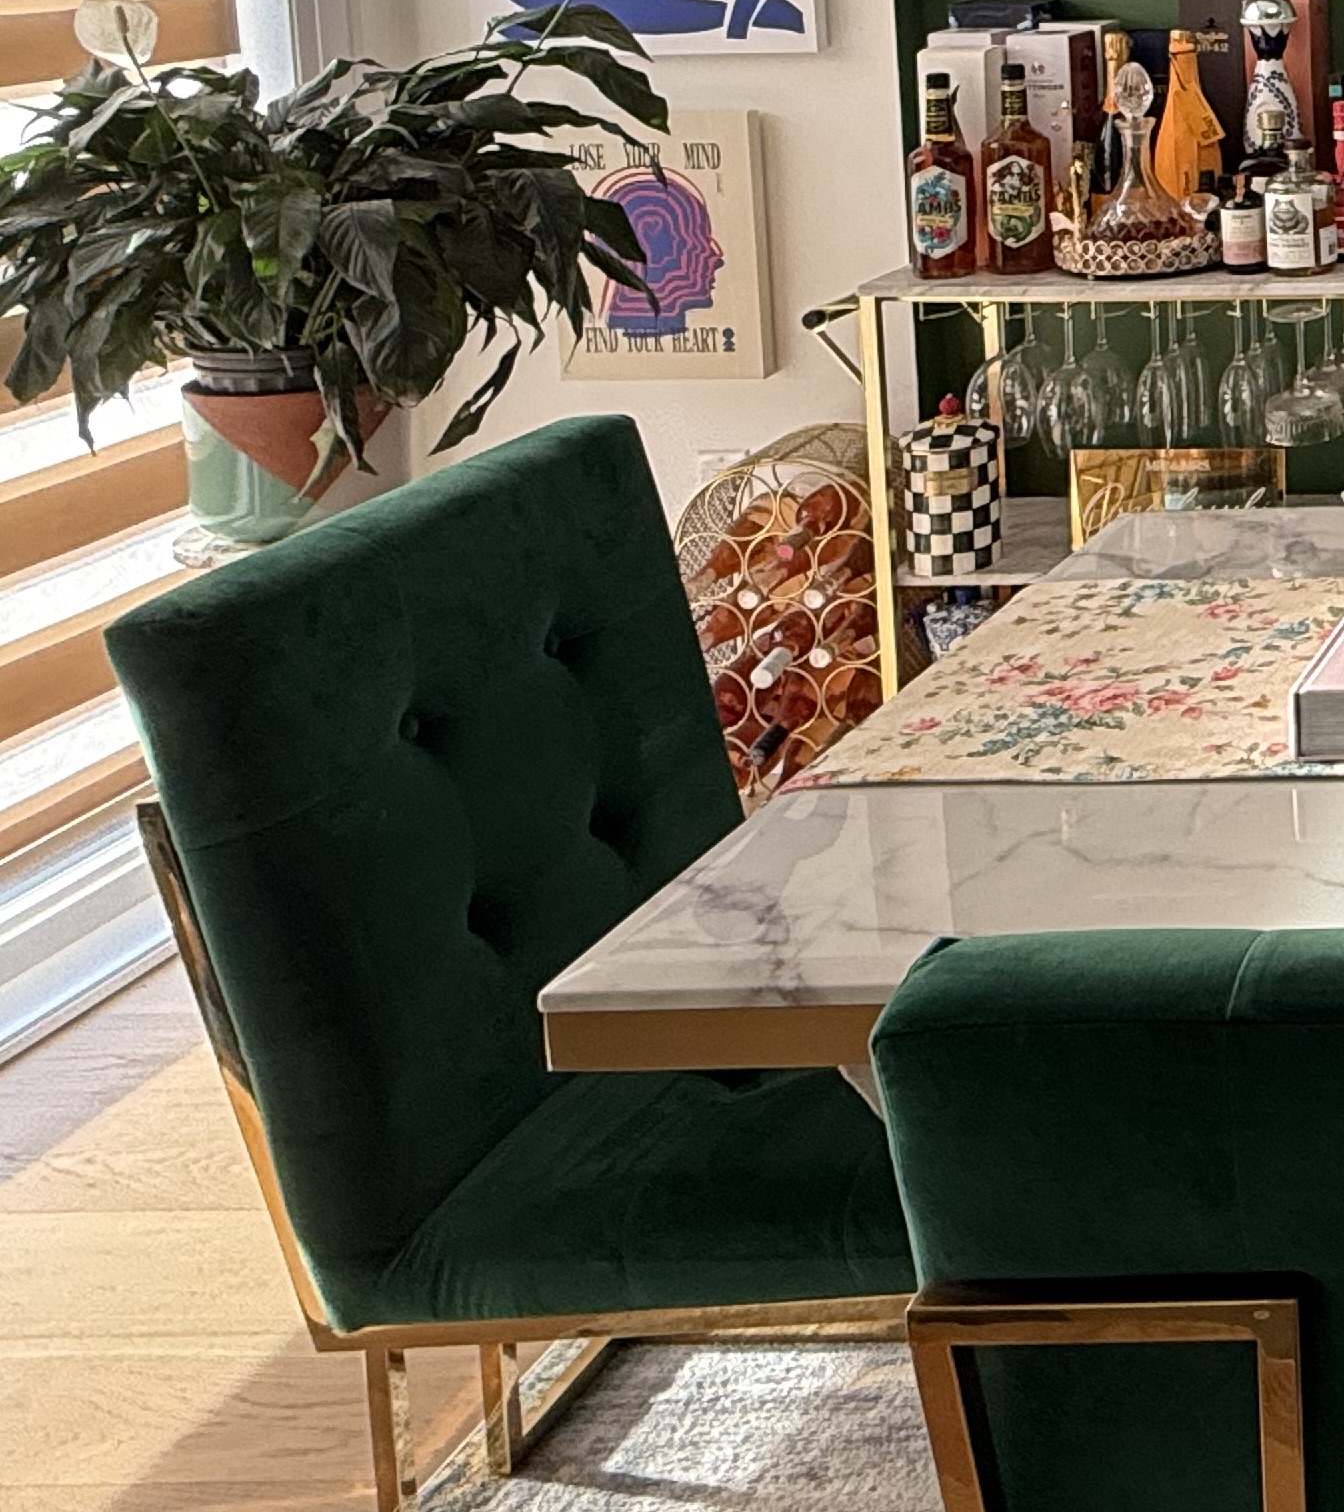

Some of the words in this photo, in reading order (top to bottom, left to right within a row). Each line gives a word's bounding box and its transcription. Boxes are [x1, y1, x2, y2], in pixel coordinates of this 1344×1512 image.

[568, 143, 607, 171] LOSE
[622, 142, 661, 169] YOUR
[682, 142, 721, 169] MIND
[585, 327, 619, 354] FIND
[672, 327, 718, 354] HEART
